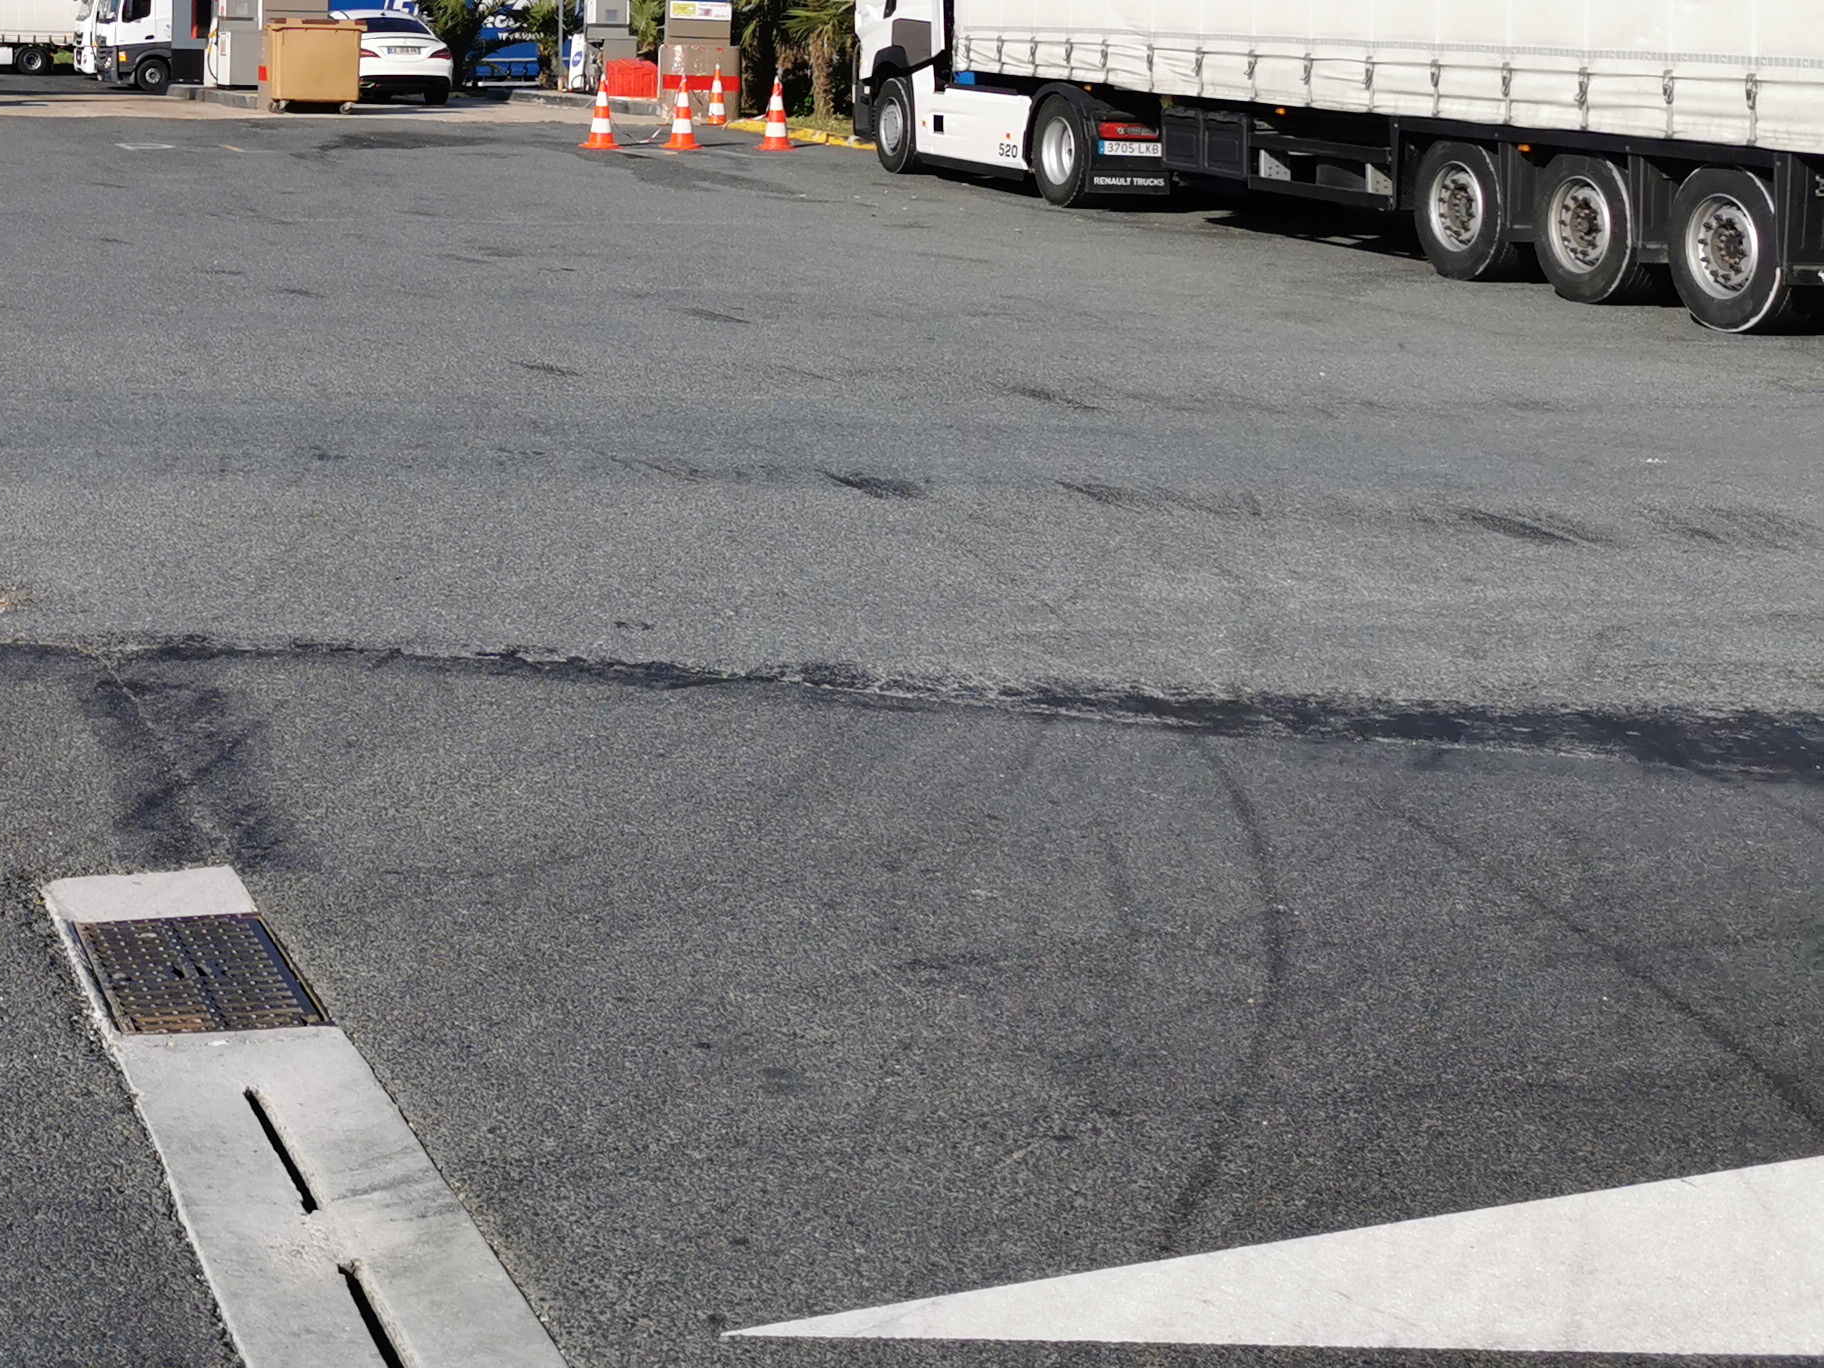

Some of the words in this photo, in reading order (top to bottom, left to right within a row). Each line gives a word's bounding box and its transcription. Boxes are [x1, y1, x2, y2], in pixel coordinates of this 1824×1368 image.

[998, 142, 1018, 159] 520
[1107, 142, 1135, 154] 3705
[1138, 143, 1160, 155] LKB
[1093, 176, 1132, 186] RENAULT
[1133, 177, 1165, 187] TRUCKS
